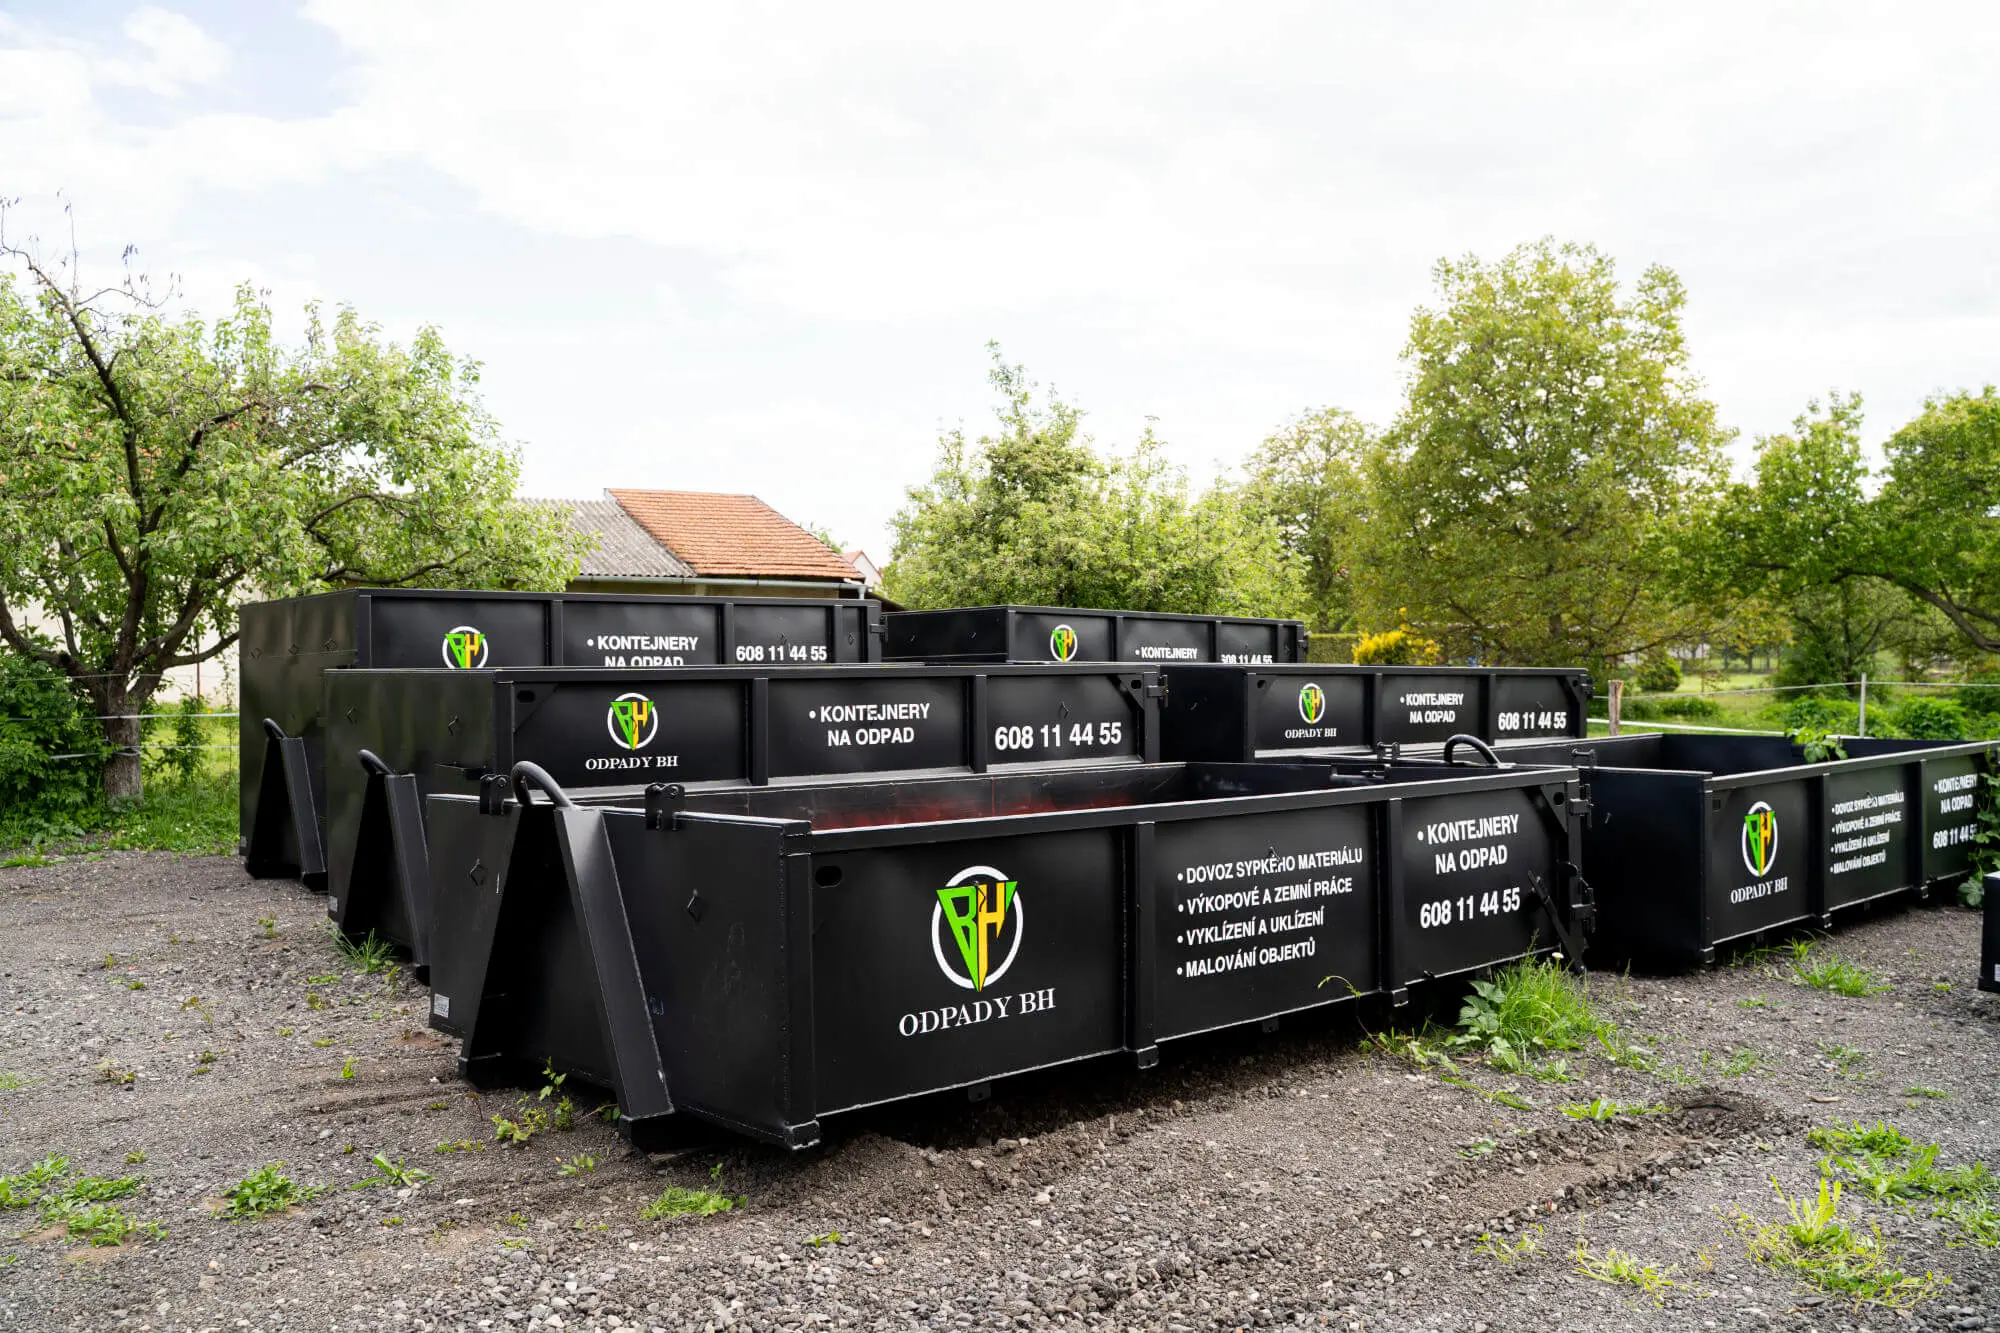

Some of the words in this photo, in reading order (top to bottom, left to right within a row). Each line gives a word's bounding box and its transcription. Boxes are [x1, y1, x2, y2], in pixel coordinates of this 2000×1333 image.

[597, 635, 698, 651] KONTEJNERY
[736, 645, 764, 661] 608
[768, 645, 784, 661] 11
[790, 645, 808, 661] 44
[810, 646, 827, 661] 55
[603, 655, 626, 667] NA
[630, 655, 685, 667] ODPAD
[1141, 648, 1198, 660] KONTEJNERY
[1406, 693, 1464, 706] KONTEJNERY
[820, 703, 930, 722] KONTEJNERY
[1410, 711, 1423, 723] NA
[1425, 710, 1455, 723] ODPAD
[1498, 712, 1520, 730] 608
[1523, 712, 1535, 729] 11
[1538, 712, 1552, 728] 44
[1553, 712, 1566, 729] 55
[828, 730, 852, 746] NA
[856, 727, 914, 745] ODPAD
[995, 726, 1033, 750] 608
[1040, 724, 1060, 747] 11
[1069, 723, 1094, 746] 44
[1099, 722, 1121, 745] 55
[1285, 728, 1322, 738] ODPADY
[1325, 728, 1336, 737] BH
[586, 757, 652, 769] ODPADY
[656, 756, 678, 767] BH
[1938, 773, 1978, 793] KONTEJNERY
[1940, 798, 1951, 814] NA
[1951, 794, 1973, 811] ODPAD
[1427, 814, 1519, 845] KONTEJNERY
[1932, 829, 1948, 849] 608
[1949, 827, 1958, 845] 11
[1960, 825, 1969, 843] 44
[1186, 865, 1233, 883] DOVOZ
[1236, 854, 1296, 878] SYPKÉHO
[1298, 846, 1362, 870] MATERIÁLU
[1435, 852, 1456, 874] NA
[1460, 845, 1507, 870] ODPAD
[1187, 889, 1260, 914] VÝKOPOVÉ
[1262, 890, 1272, 905] A
[1274, 879, 1311, 902] ZEMNÍ
[1314, 877, 1352, 896] PRÁCE
[1731, 881, 1773, 904] ODPADY
[1775, 877, 1787, 892] BH
[1420, 900, 1451, 928] 608
[1457, 896, 1473, 921] 11
[1480, 891, 1499, 916] 44
[1503, 887, 1520, 912] 55
[1187, 919, 1255, 945] VYKLÍZENÍ
[1257, 919, 1268, 936] A
[1271, 906, 1324, 932] UKLÍZENÍ
[1186, 950, 1256, 977] MALOVÁNÍ
[1259, 936, 1315, 964] OBJEKTŮ
[899, 996, 1012, 1036] ODPADY
[1019, 988, 1056, 1014] BH
